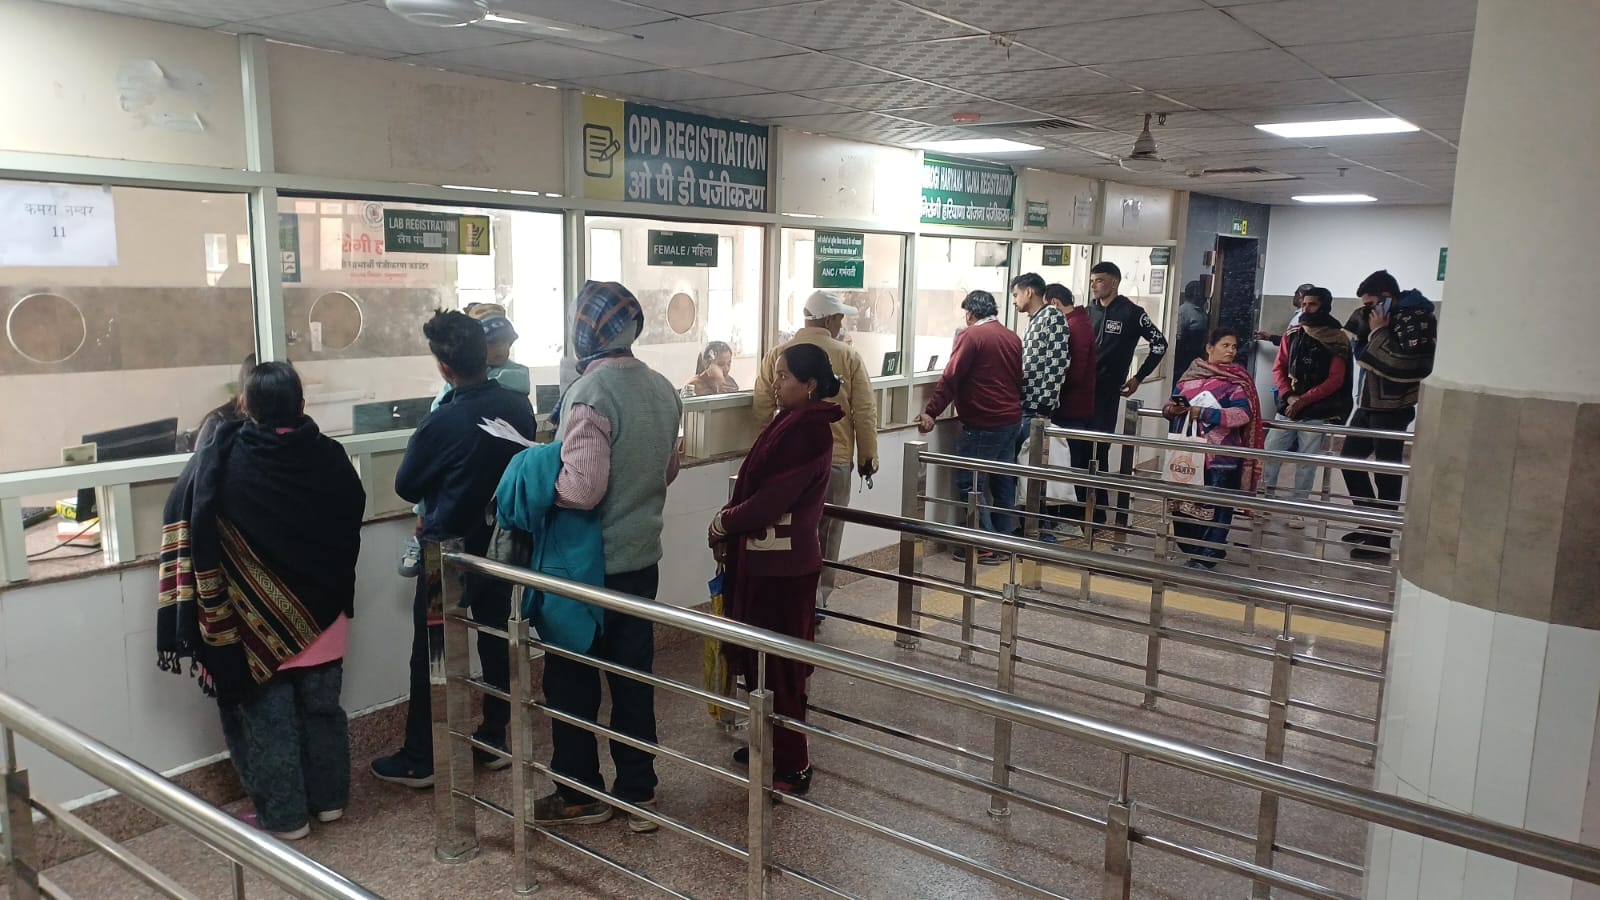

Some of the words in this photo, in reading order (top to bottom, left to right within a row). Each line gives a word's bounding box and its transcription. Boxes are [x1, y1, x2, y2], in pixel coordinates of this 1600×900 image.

[629, 114, 661, 155] OPD
[665, 120, 766, 171] REGISTRATION
[629, 161, 651, 199] ओ
[656, 162, 674, 201] पी
[678, 165, 695, 205] डी
[699, 170, 766, 210] पंजीकरण
[23, 203, 57, 216] कमरा
[389, 216, 404, 230] LAB
[405, 218, 456, 232] REGISTRATION
[52, 226, 67, 238] 11
[653, 243, 686, 256] FEMALE
[691, 243, 713, 257] महिला
[821, 267, 835, 277] ANC
[887, 358, 895, 371] 10
